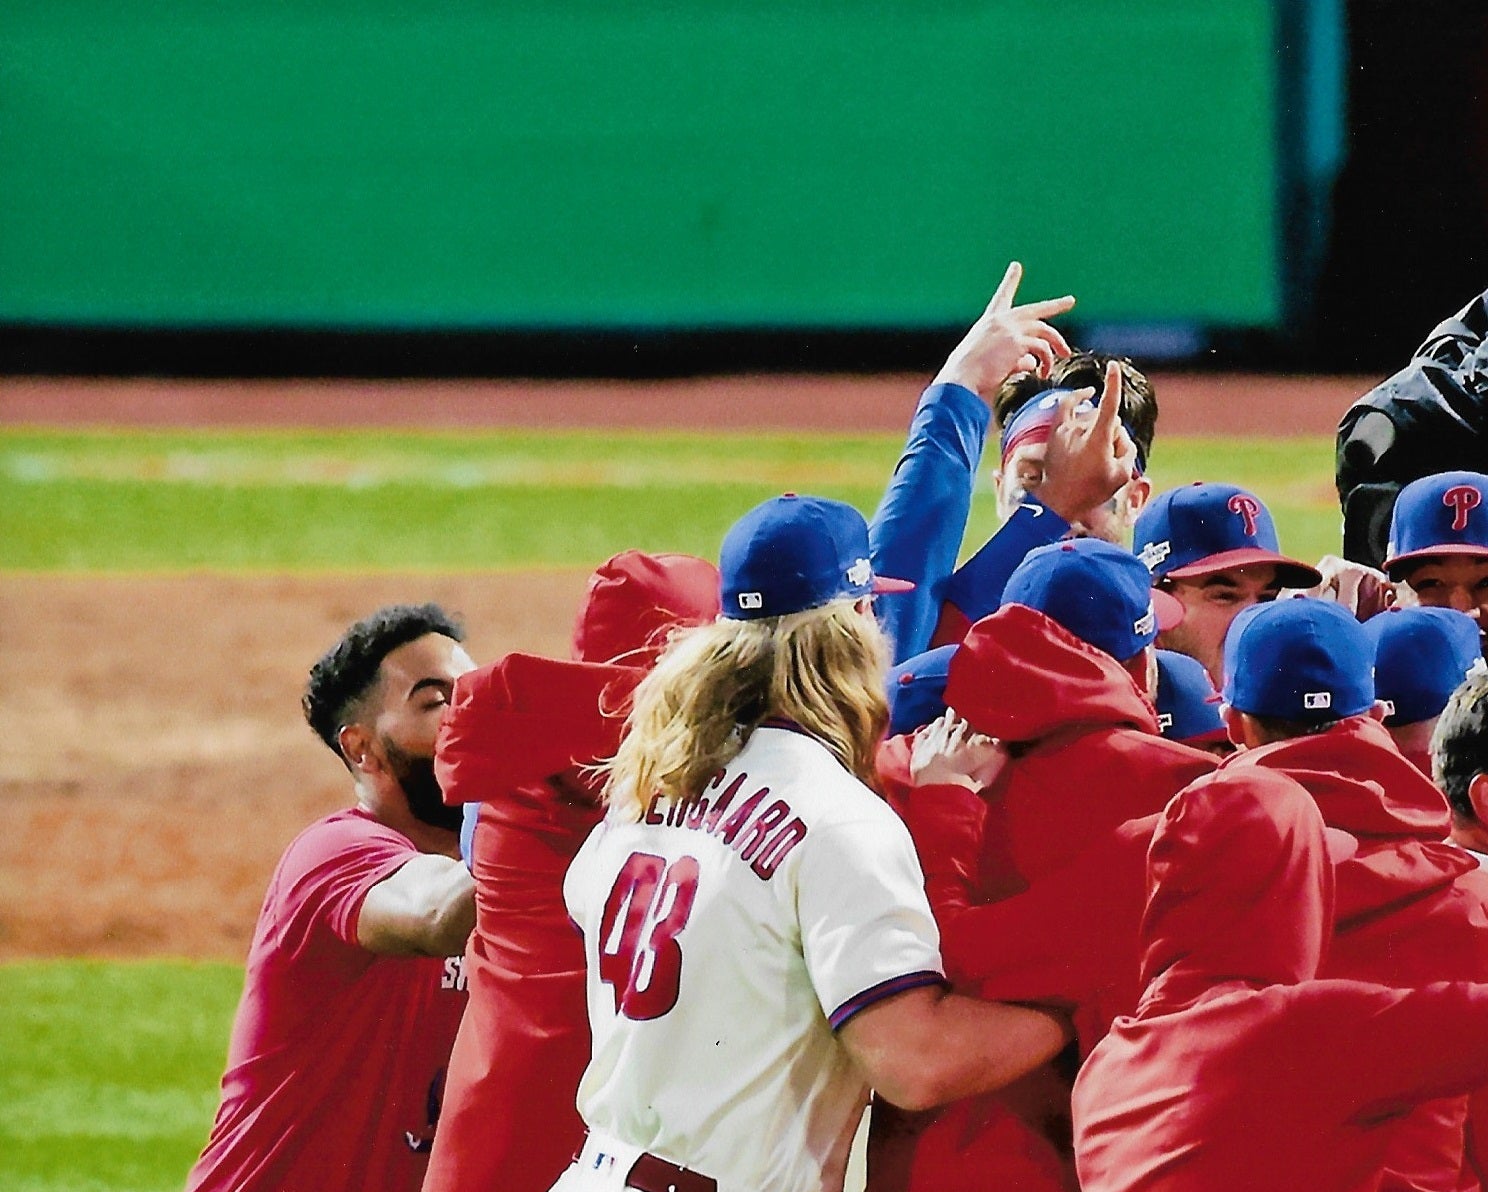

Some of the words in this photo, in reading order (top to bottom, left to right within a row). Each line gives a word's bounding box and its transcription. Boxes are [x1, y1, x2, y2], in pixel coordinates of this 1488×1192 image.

[1228, 494, 1261, 537] P
[1442, 485, 1481, 531] P
[599, 851, 700, 1021] 48
